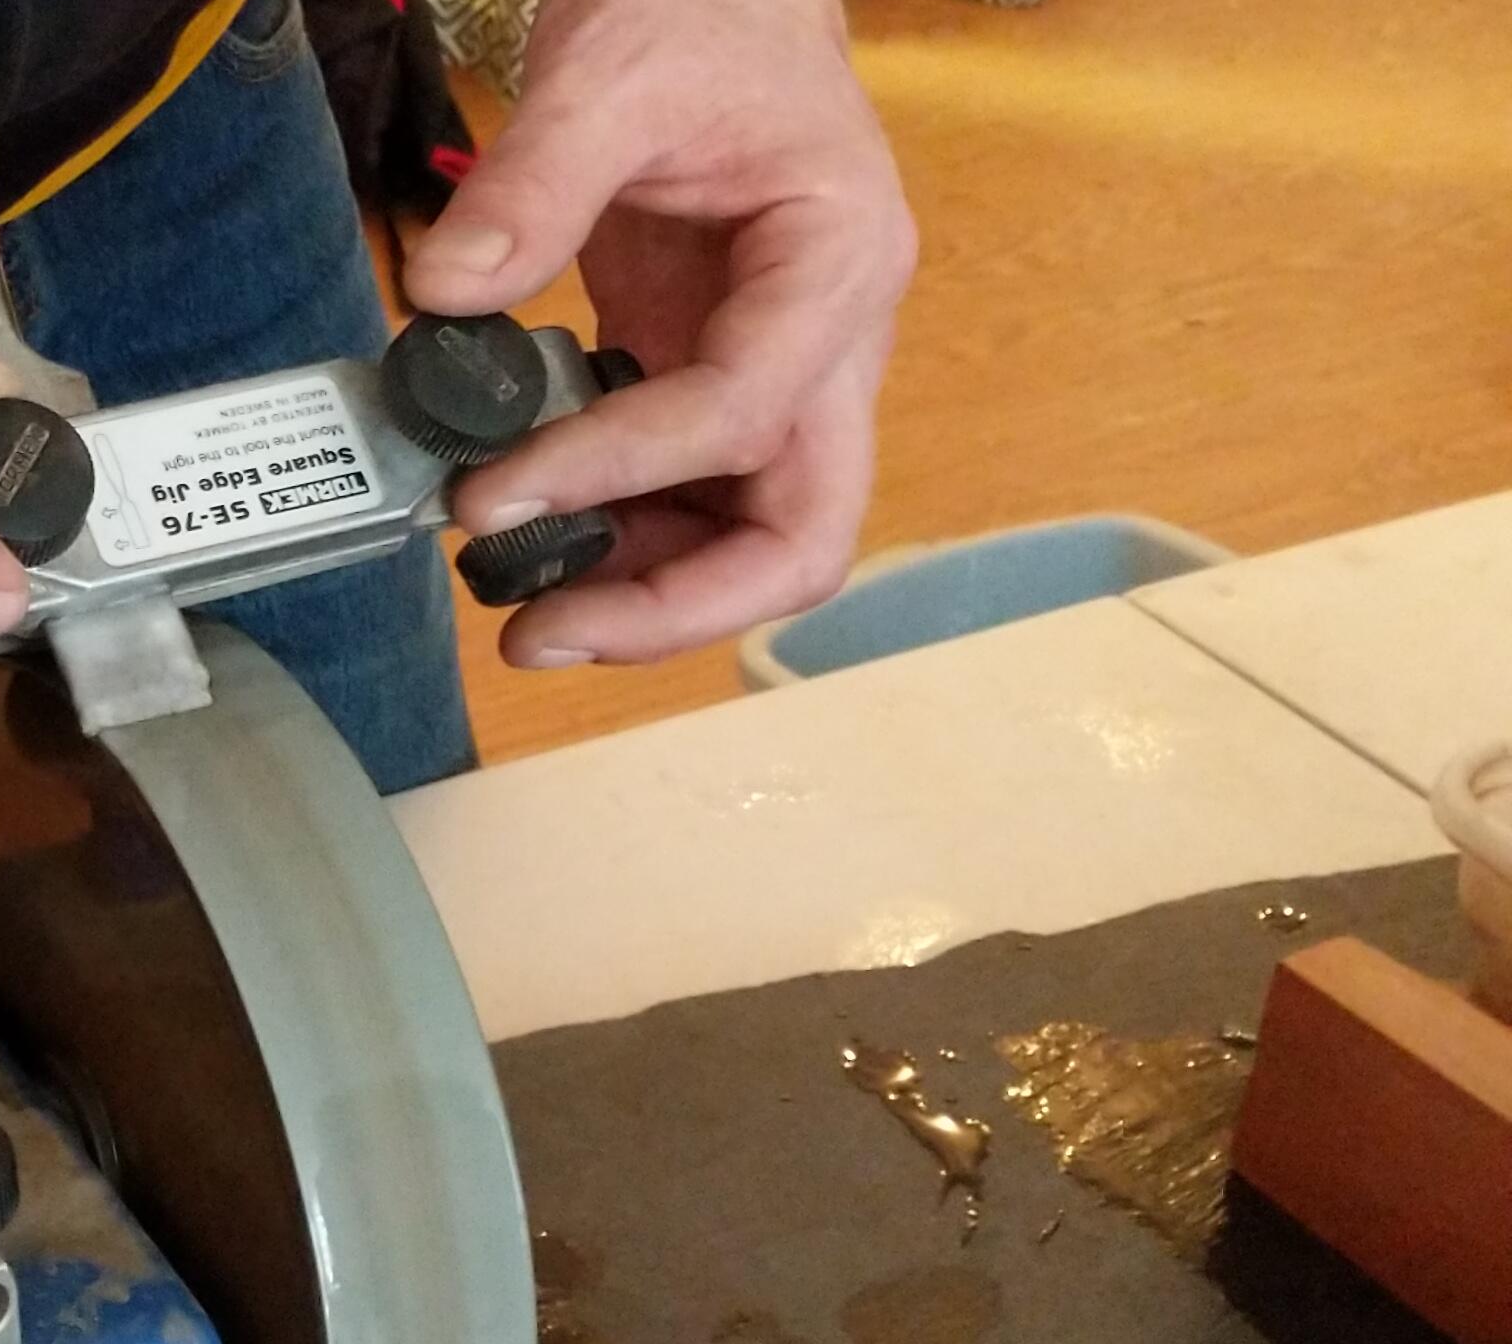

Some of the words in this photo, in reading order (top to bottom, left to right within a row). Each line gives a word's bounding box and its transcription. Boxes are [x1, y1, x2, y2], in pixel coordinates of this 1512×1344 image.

[250, 415, 267, 427] BY
[269, 402, 334, 423] PATENTED
[192, 421, 246, 439] TORMEK
[296, 422, 345, 442] Mount
[241, 439, 270, 455] tool
[272, 433, 296, 448] the
[197, 449, 221, 465] the
[223, 444, 240, 458] to
[265, 443, 356, 479] Square
[160, 452, 195, 472] right
[196, 464, 262, 496] Edge
[150, 479, 192, 506] Jig
[259, 471, 369, 514] TORMEK
[159, 499, 251, 537] SE-76
